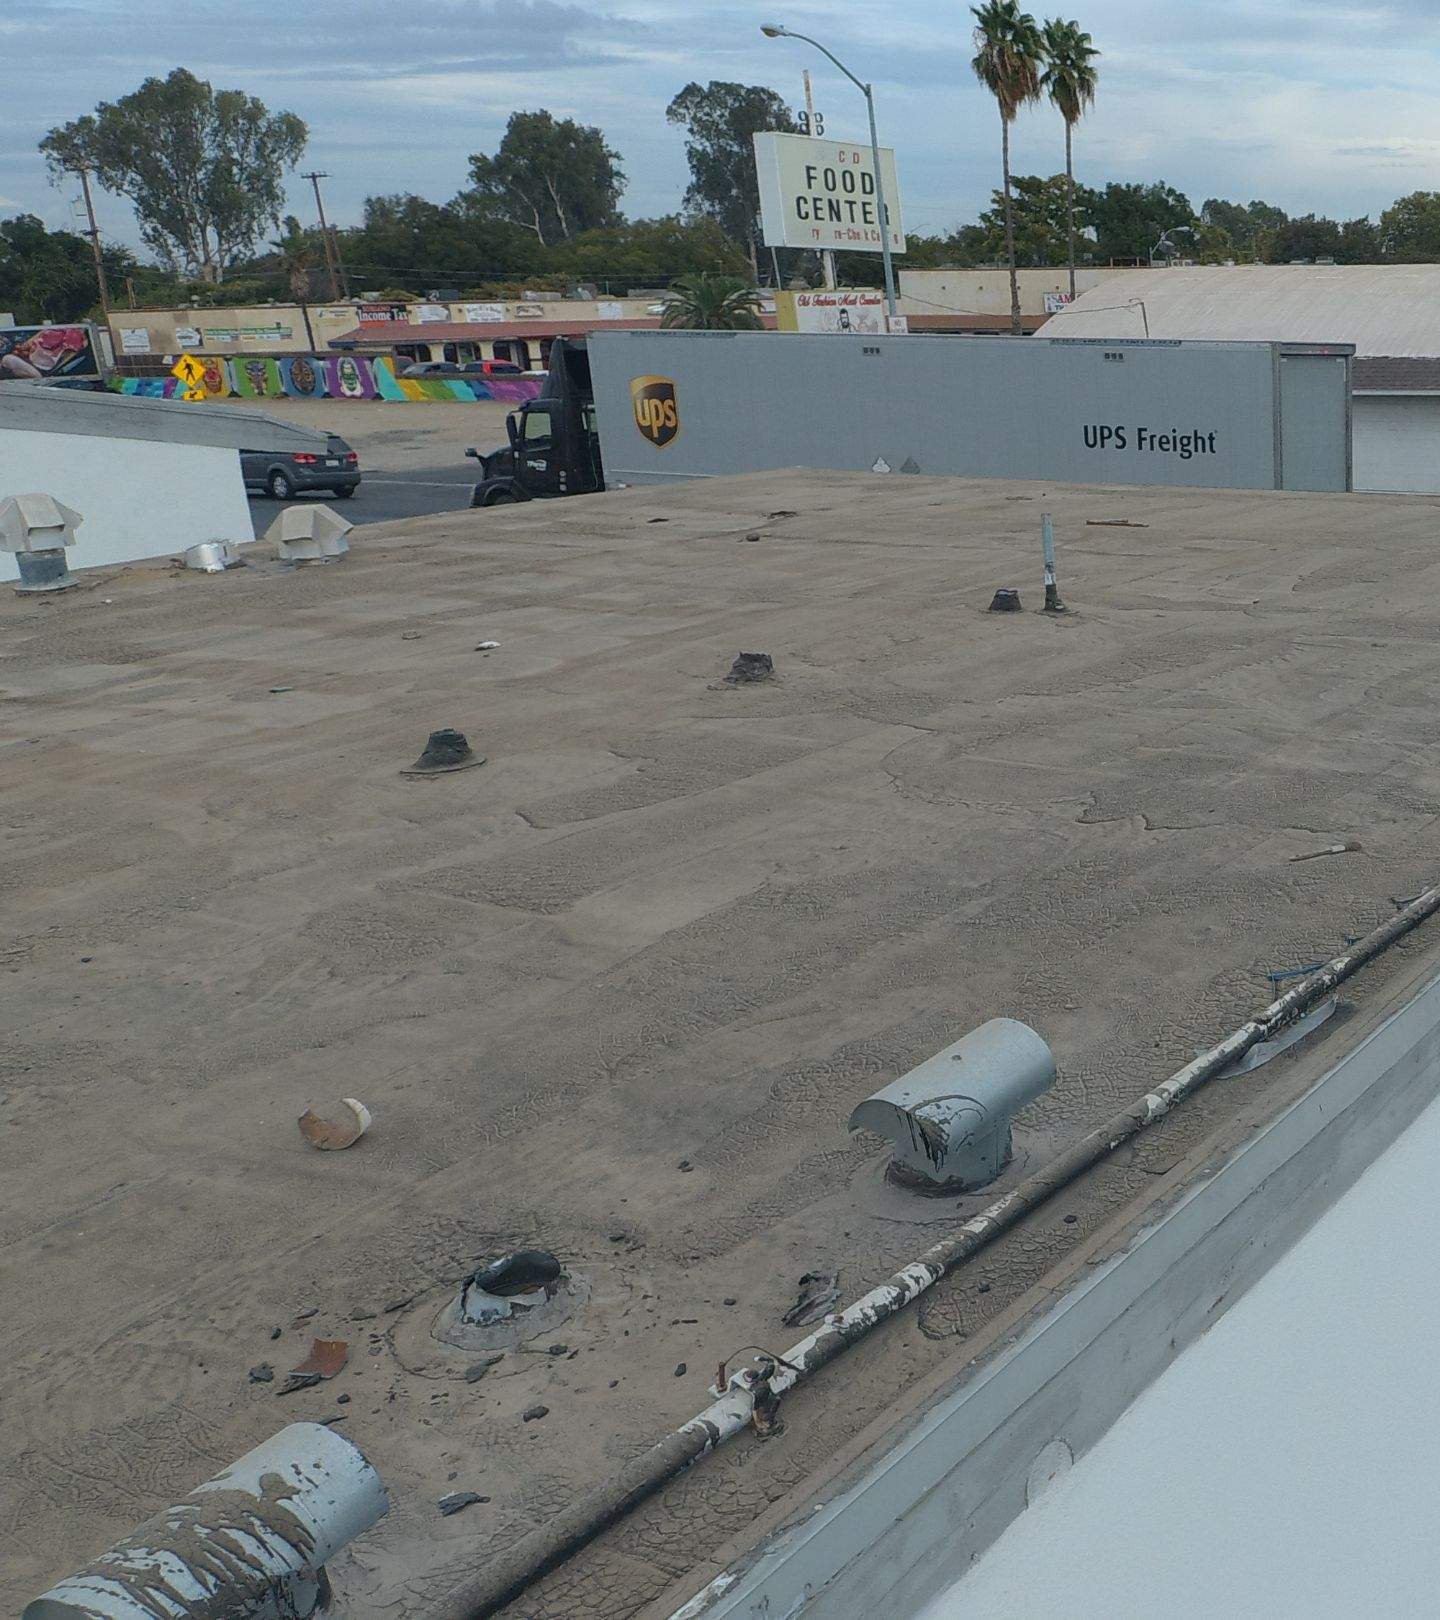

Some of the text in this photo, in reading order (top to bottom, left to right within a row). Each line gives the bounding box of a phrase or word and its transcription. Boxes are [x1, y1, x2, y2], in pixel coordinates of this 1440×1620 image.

[805, 165, 875, 195] FOOD
[357, 309, 391, 321] Income
[391, 308, 409, 320] Tax
[635, 399, 677, 438] ups
[1083, 424, 1216, 459] UPS Freight
